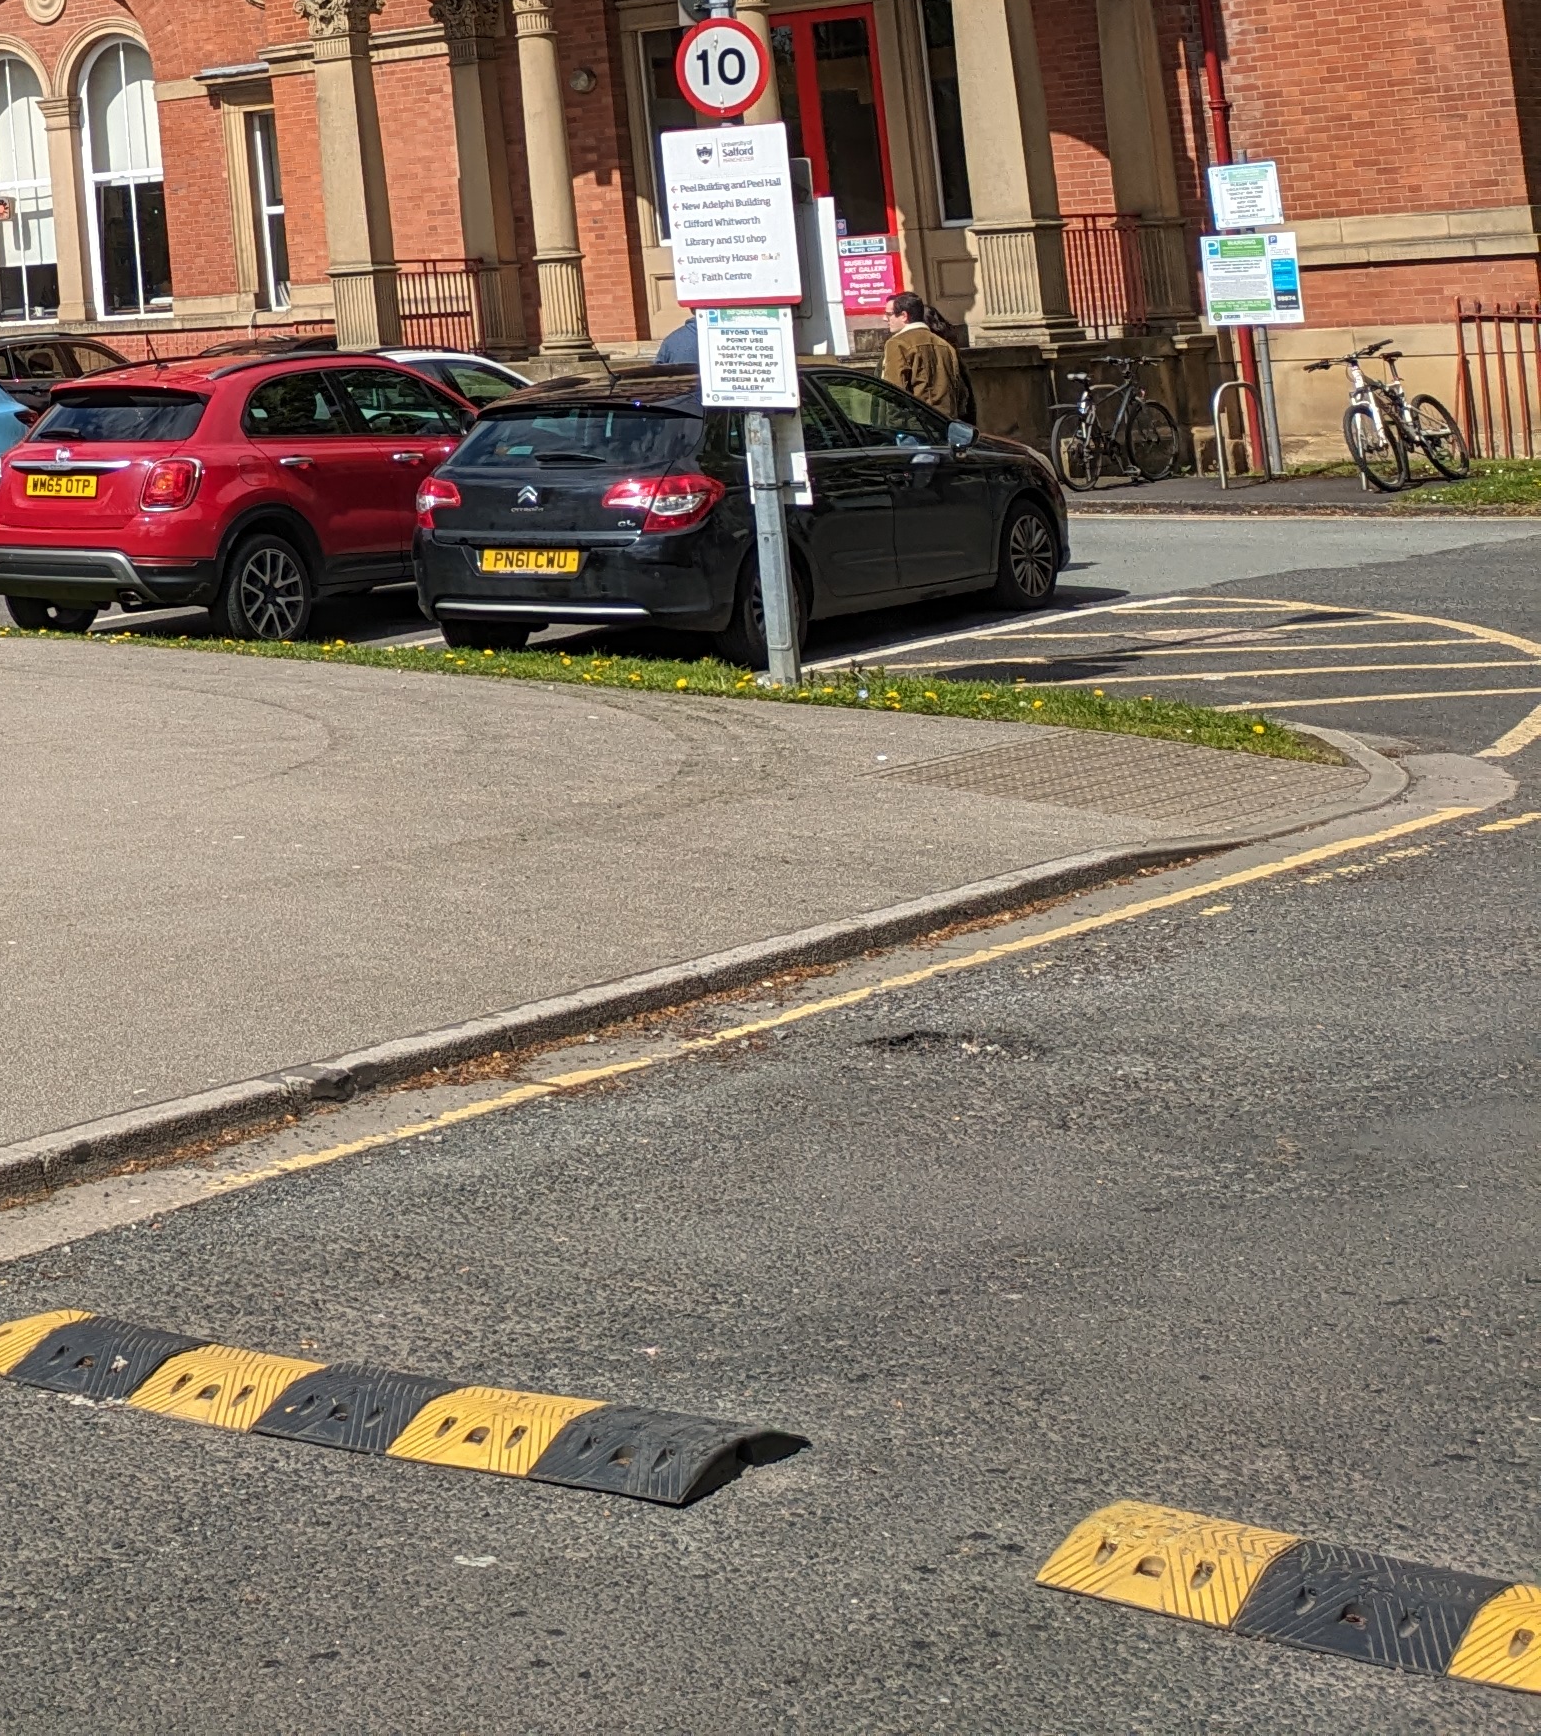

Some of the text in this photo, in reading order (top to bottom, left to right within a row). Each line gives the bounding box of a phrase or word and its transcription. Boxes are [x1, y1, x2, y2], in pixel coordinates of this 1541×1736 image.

[696, 47, 746, 86] 10
[722, 145, 754, 157] Salford
[679, 177, 782, 193] Peel Building and Peel Hall
[681, 197, 771, 211] New Adelphi Building
[683, 215, 761, 229] Clifford Whitworth
[684, 234, 767, 248] Library and SU shop
[686, 254, 731, 265] University
[731, 253, 759, 262] House
[701, 271, 753, 282] Faith Centre
[32, 477, 91, 494] WM65 OTP
[493, 551, 568, 569] PN61 CWU
